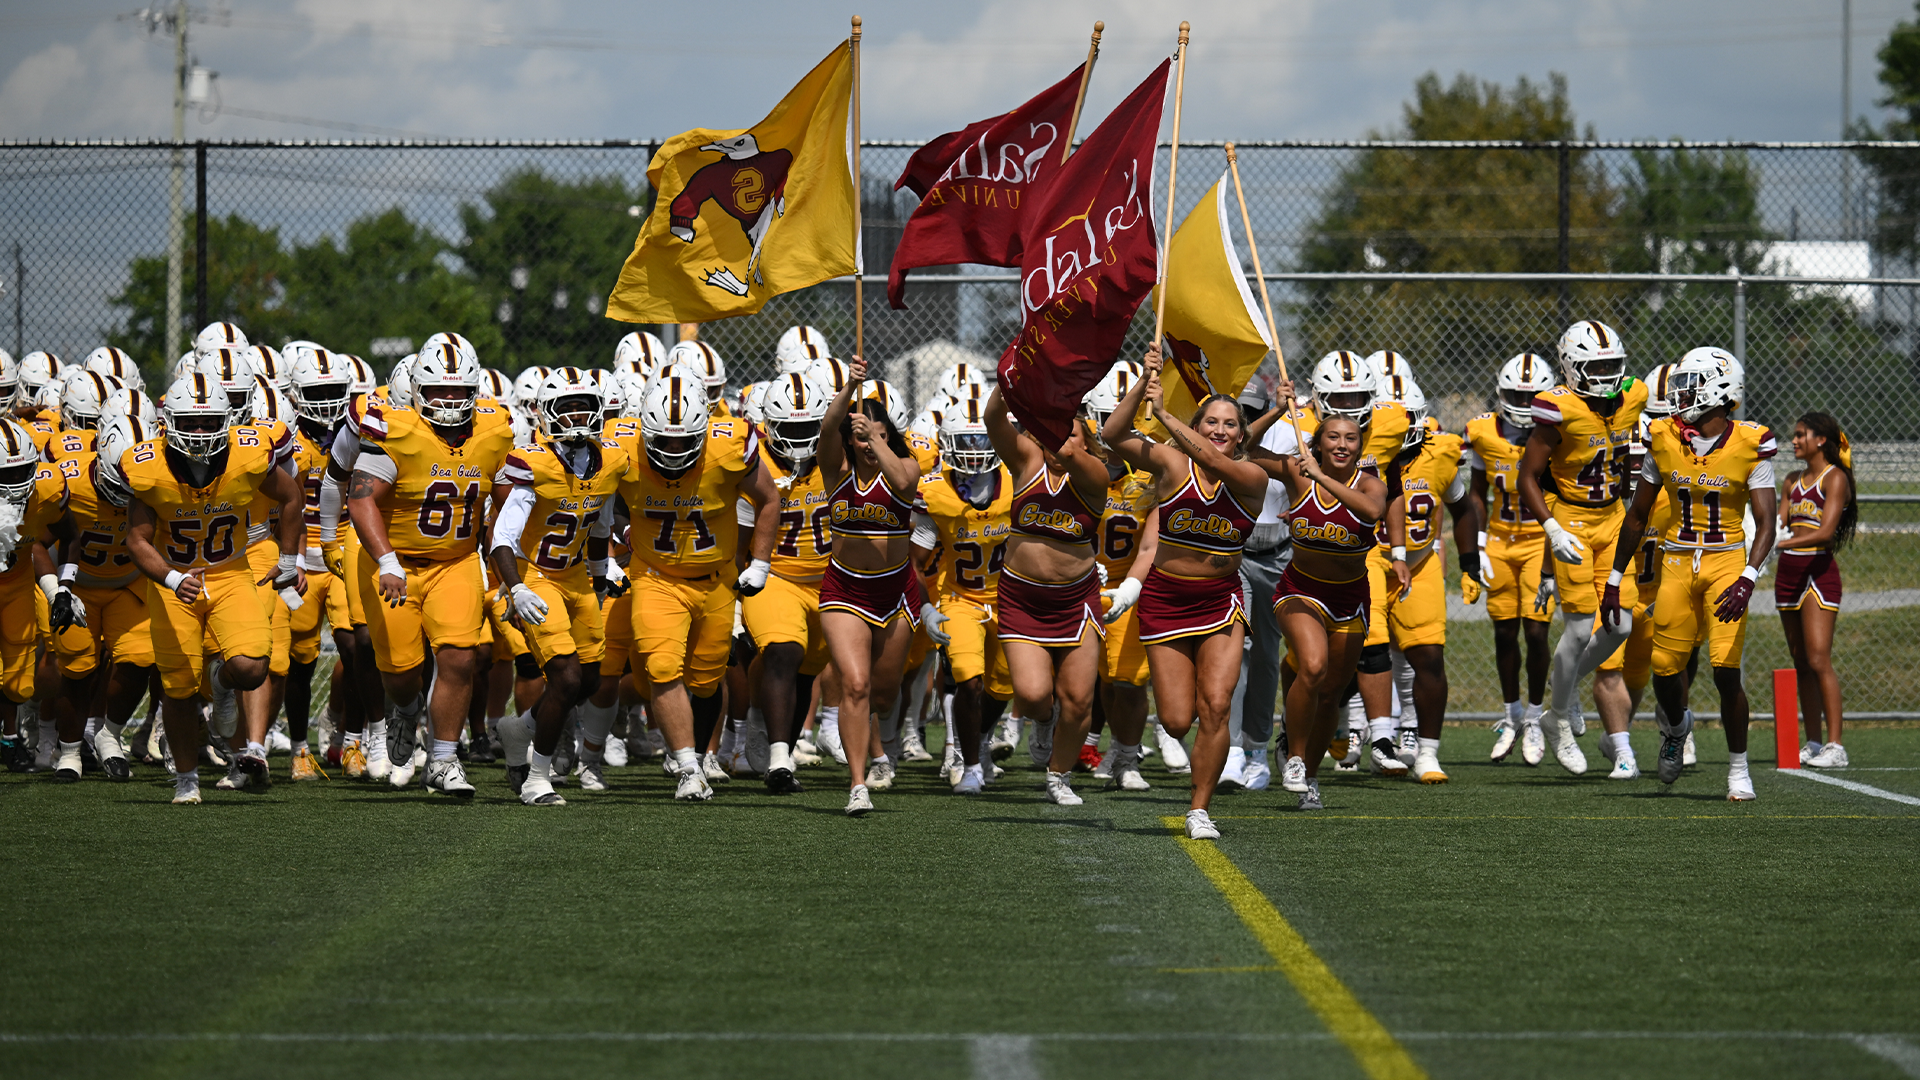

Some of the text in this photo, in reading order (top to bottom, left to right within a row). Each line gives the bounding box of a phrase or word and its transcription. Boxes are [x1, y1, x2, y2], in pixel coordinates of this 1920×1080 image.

[237, 428, 260, 447] 50
[614, 421, 638, 439] 71
[711, 421, 734, 439] 71
[1587, 434, 1606, 447] Sea
[132, 442, 156, 465] 50
[58, 459, 81, 480] 53
[308, 466, 322, 475] ea
[429, 463, 482, 478] Sea Gulls
[1670, 470, 1730, 488] Sea Gulls
[1404, 478, 1430, 491] Gulls
[558, 497, 579, 510] Sea
[645, 494, 705, 508] Sea Gulls
[780, 490, 828, 508] Sea Gull
[1105, 497, 1135, 513] Gulls
[174, 500, 235, 519] Sea Gulls
[416, 480, 480, 541] 61
[831, 499, 900, 528] Gulls
[1676, 486, 1727, 545] 11
[776, 503, 832, 557] 70
[957, 521, 1012, 539] Sea Gulls
[1018, 502, 1084, 539] Gulls
[1167, 508, 1242, 543] Gulls
[534, 510, 601, 570] 27
[643, 507, 718, 554] 71
[1291, 516, 1362, 548] Gulls
[165, 514, 240, 567] 50
